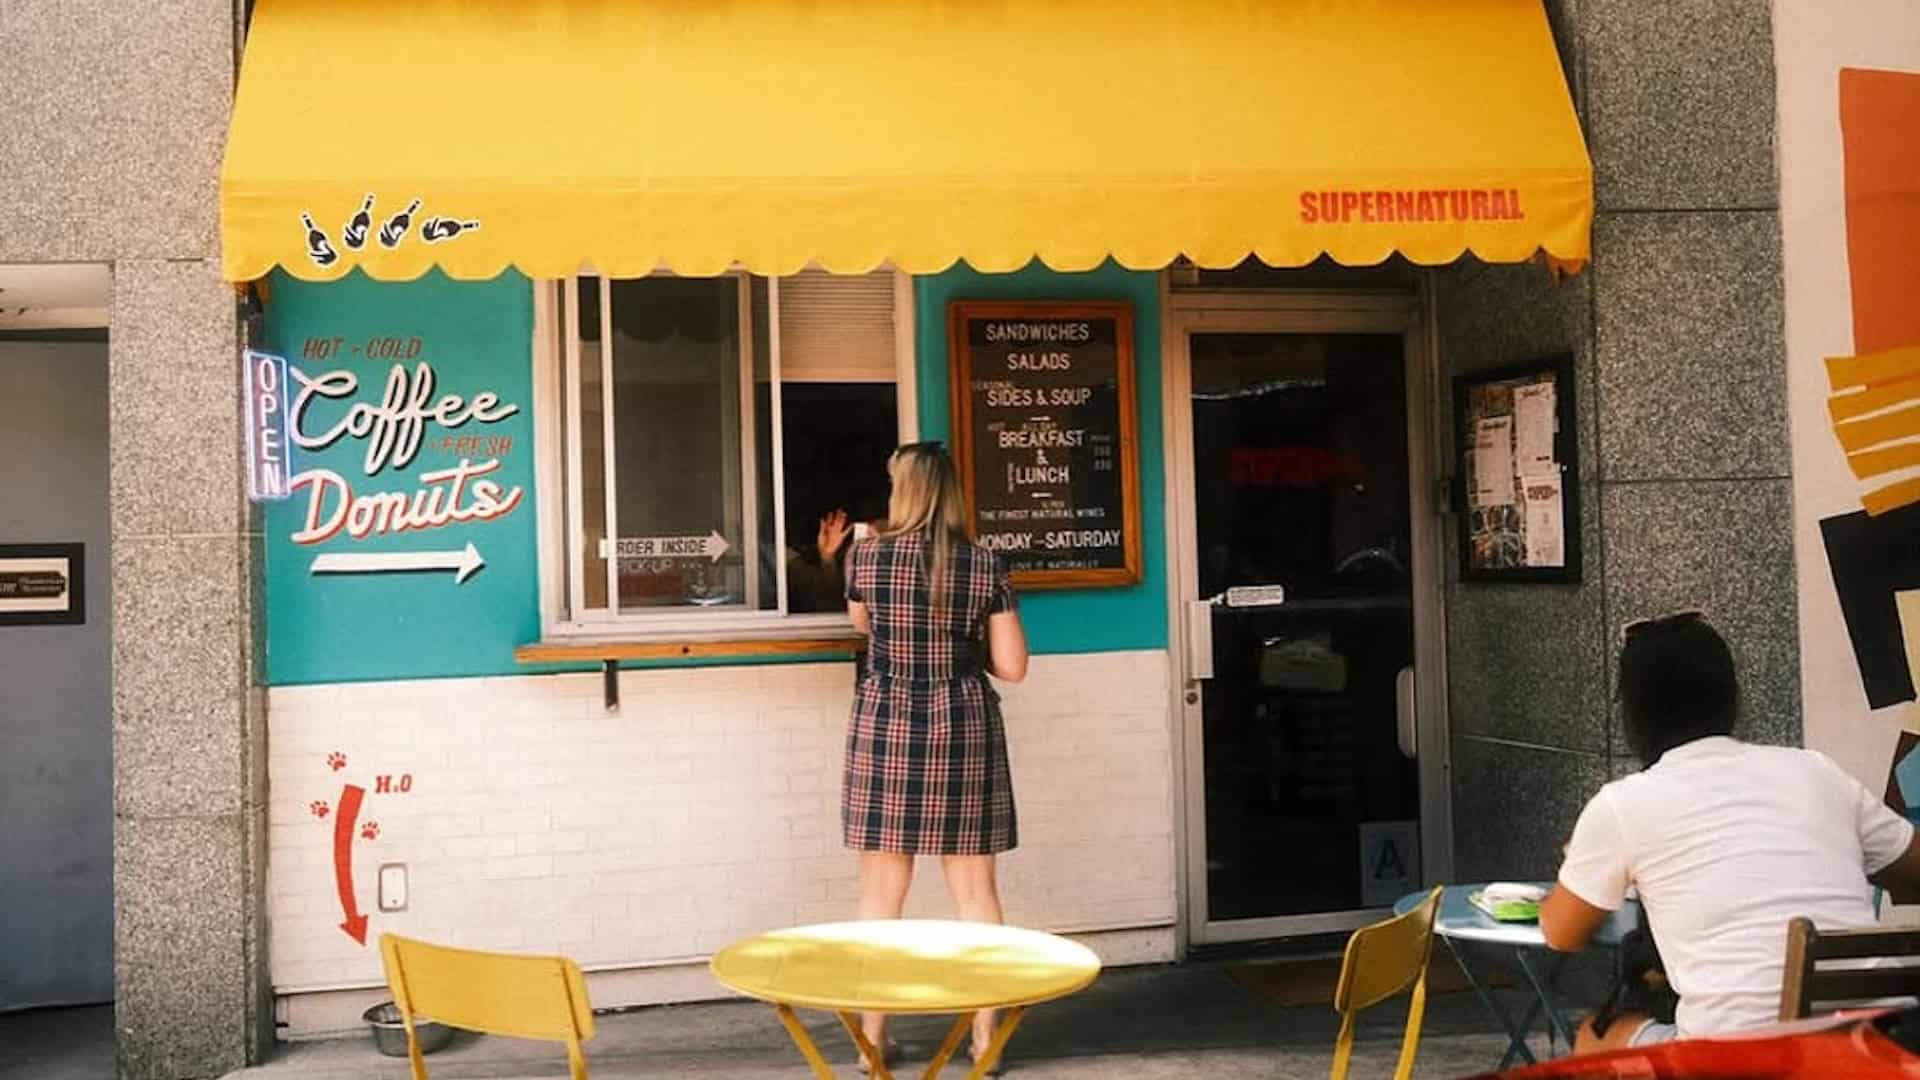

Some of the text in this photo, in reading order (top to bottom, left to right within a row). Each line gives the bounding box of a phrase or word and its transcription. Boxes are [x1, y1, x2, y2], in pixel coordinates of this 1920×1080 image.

[1300, 189, 1524, 223] SUPERNATURAL
[985, 322, 1089, 341] SANDWICHES
[303, 338, 344, 360] HOT
[366, 337, 422, 360] COLD
[1007, 352, 1071, 371] SALADS
[987, 387, 1092, 408] SIDES & SOUP
[259, 358, 281, 496] OPEN
[289, 361, 519, 475] Coffee
[440, 436, 512, 456] FRESH
[999, 430, 1085, 449] BREAKFAST
[1036, 449, 1049, 465] &
[1015, 466, 1070, 485] LUNCH
[290, 458, 523, 545] Donuts
[615, 539, 706, 555] RDER INSIDE
[1045, 529, 1121, 549] SATURDAY
[1372, 838, 1408, 880] A
